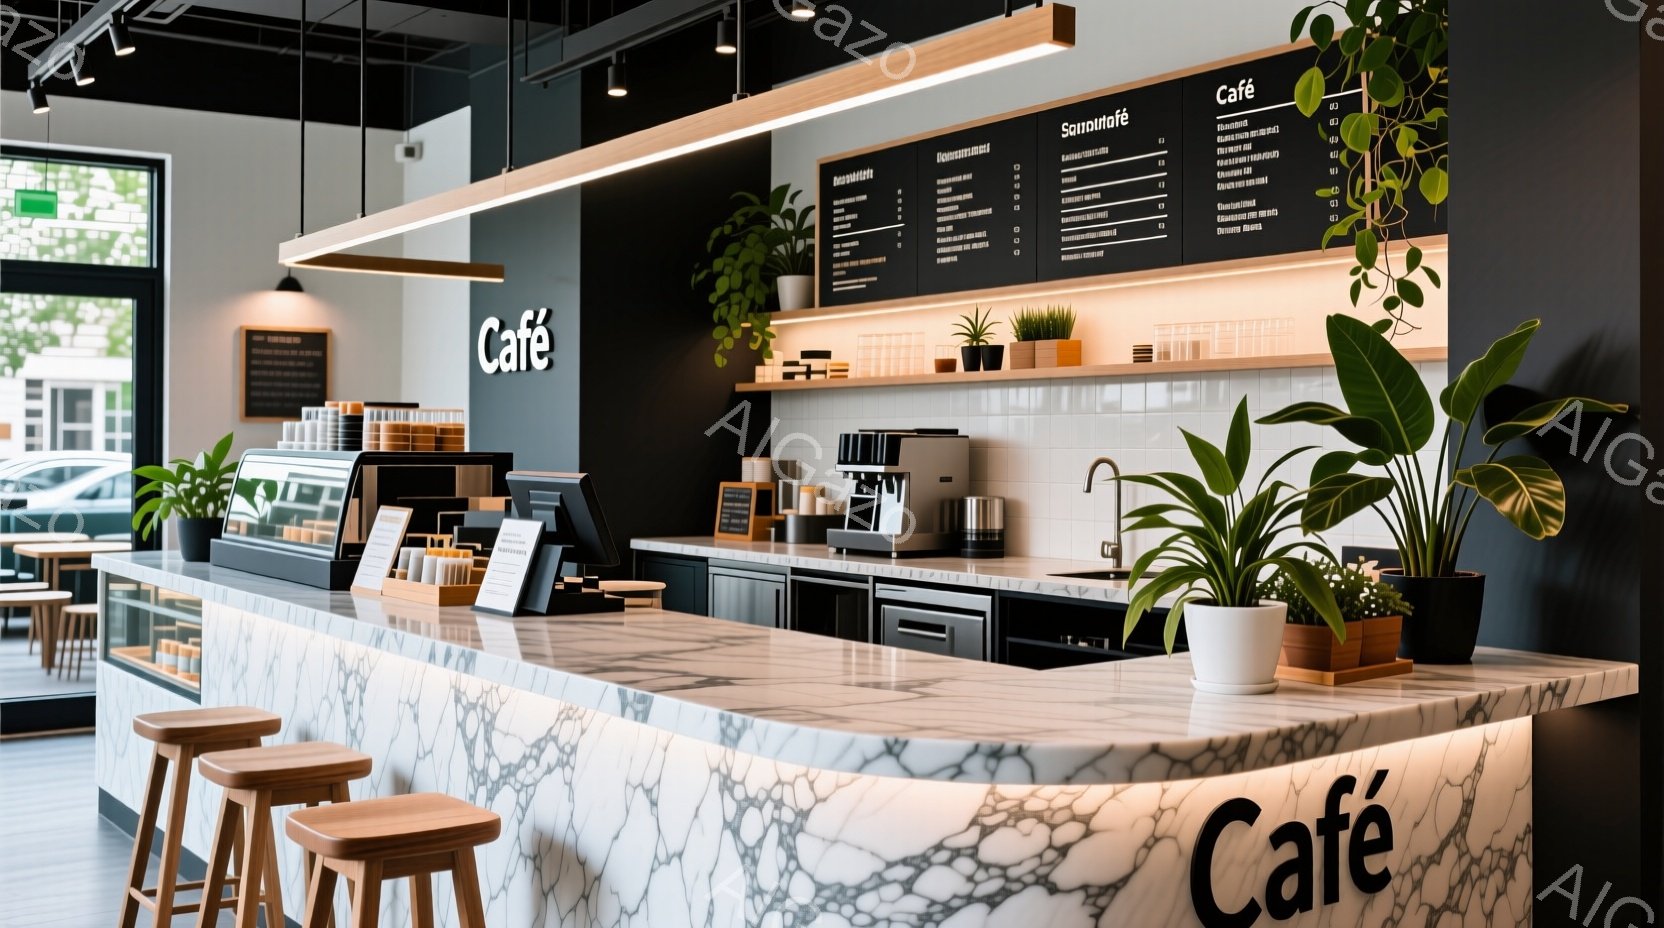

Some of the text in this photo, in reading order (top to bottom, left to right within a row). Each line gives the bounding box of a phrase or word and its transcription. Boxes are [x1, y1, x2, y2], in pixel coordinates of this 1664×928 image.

[1216, 78, 1255, 105] Café
[477, 307, 550, 375] Café
[1190, 769, 1394, 928] Café
